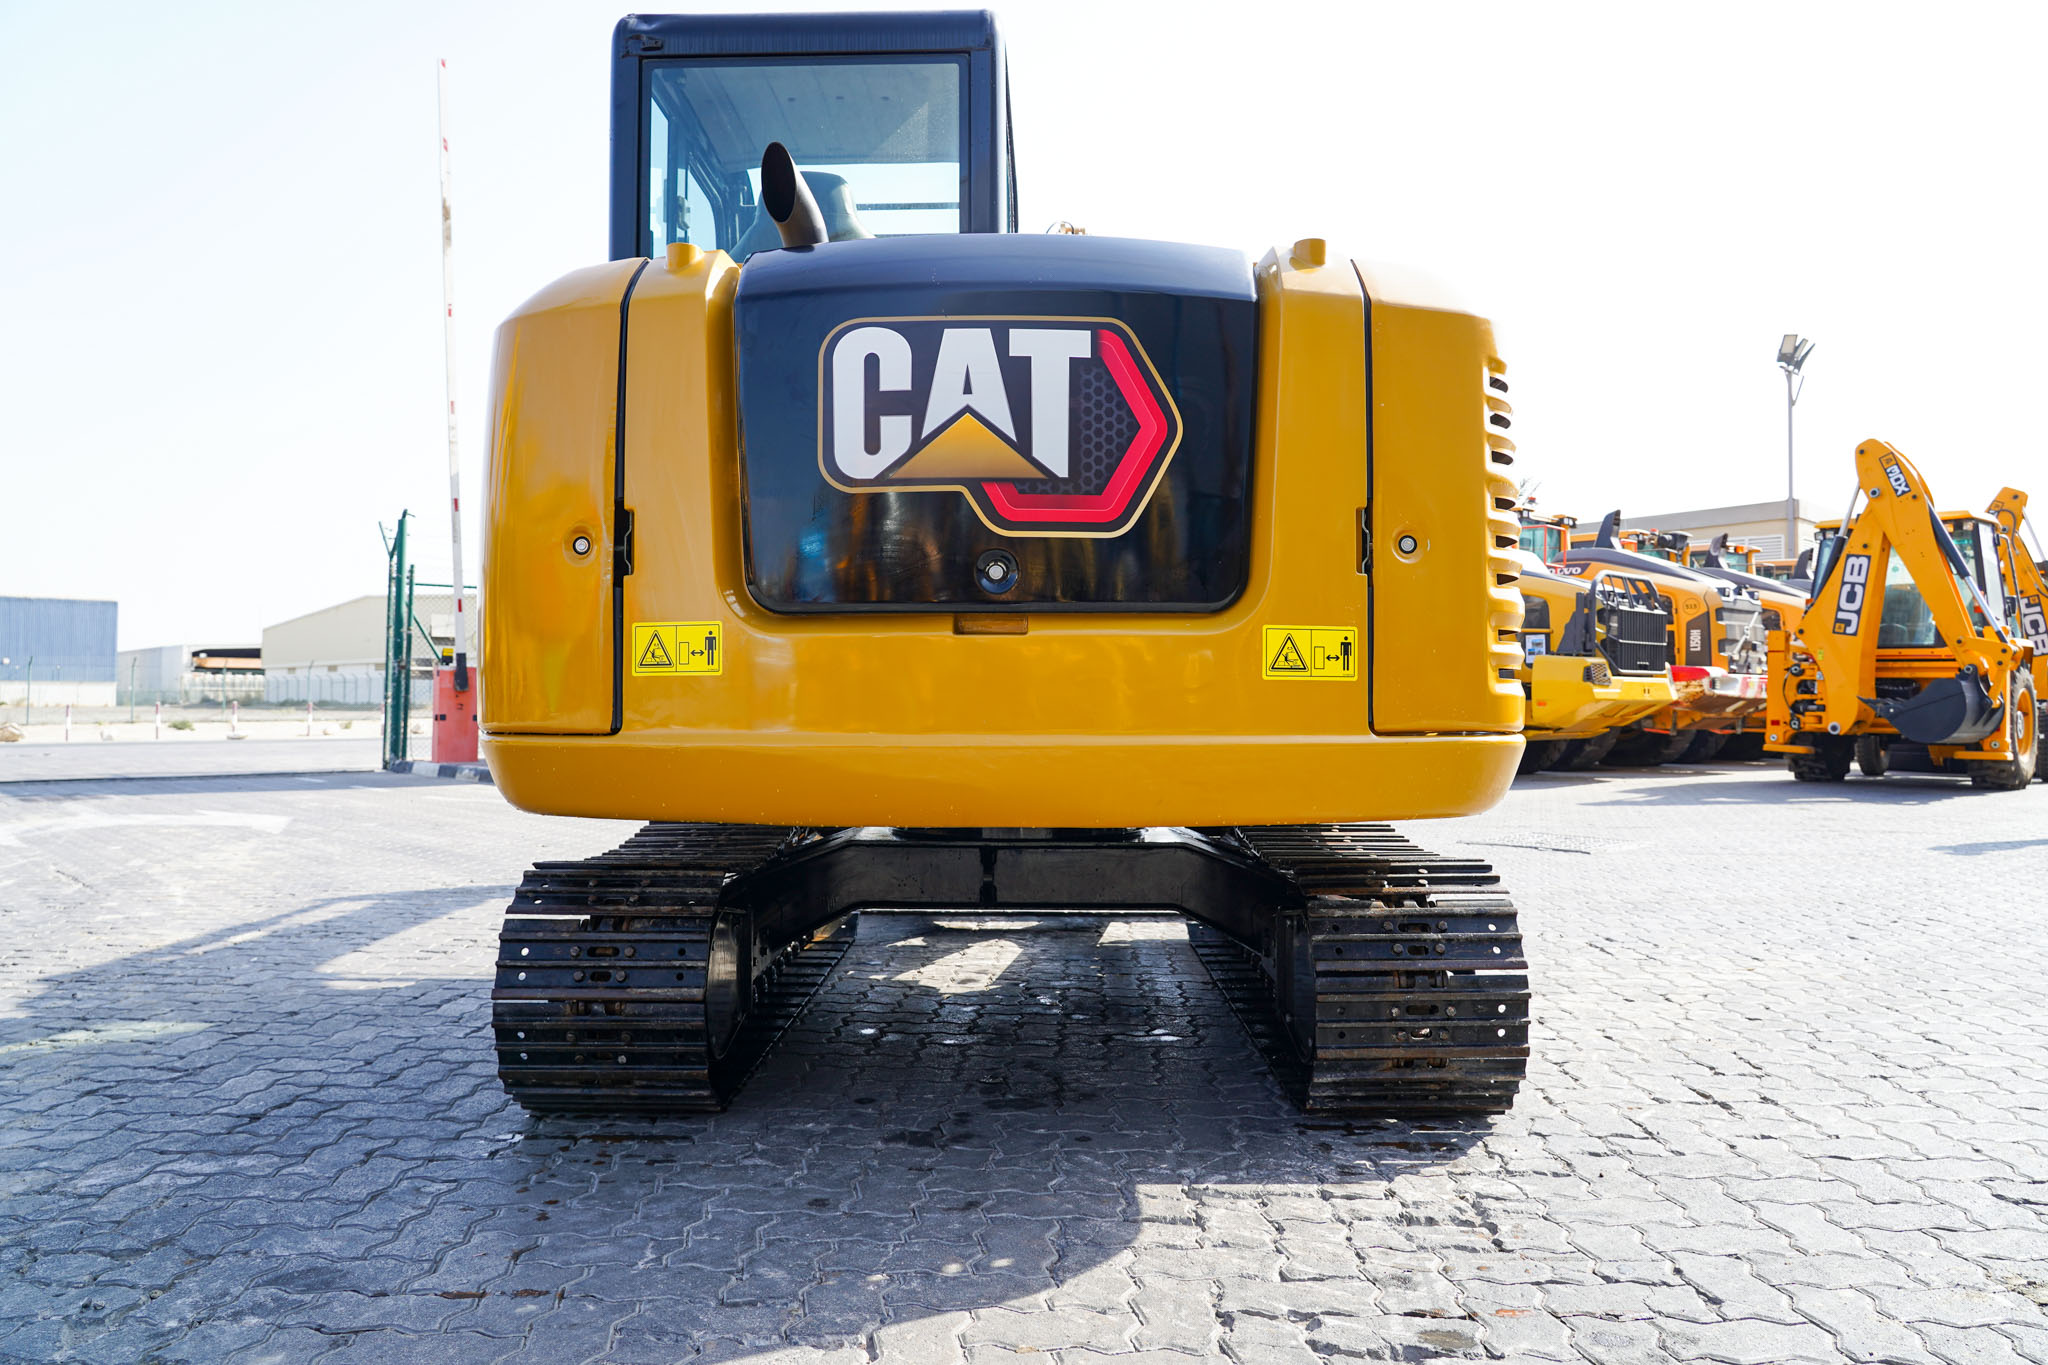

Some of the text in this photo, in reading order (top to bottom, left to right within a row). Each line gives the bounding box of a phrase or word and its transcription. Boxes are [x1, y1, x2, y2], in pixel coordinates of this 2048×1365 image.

[832, 326, 1092, 480] CAT
[1885, 464, 1911, 496] 3DX
[1836, 556, 1869, 635] JCB
[2020, 597, 2048, 656] JCB
